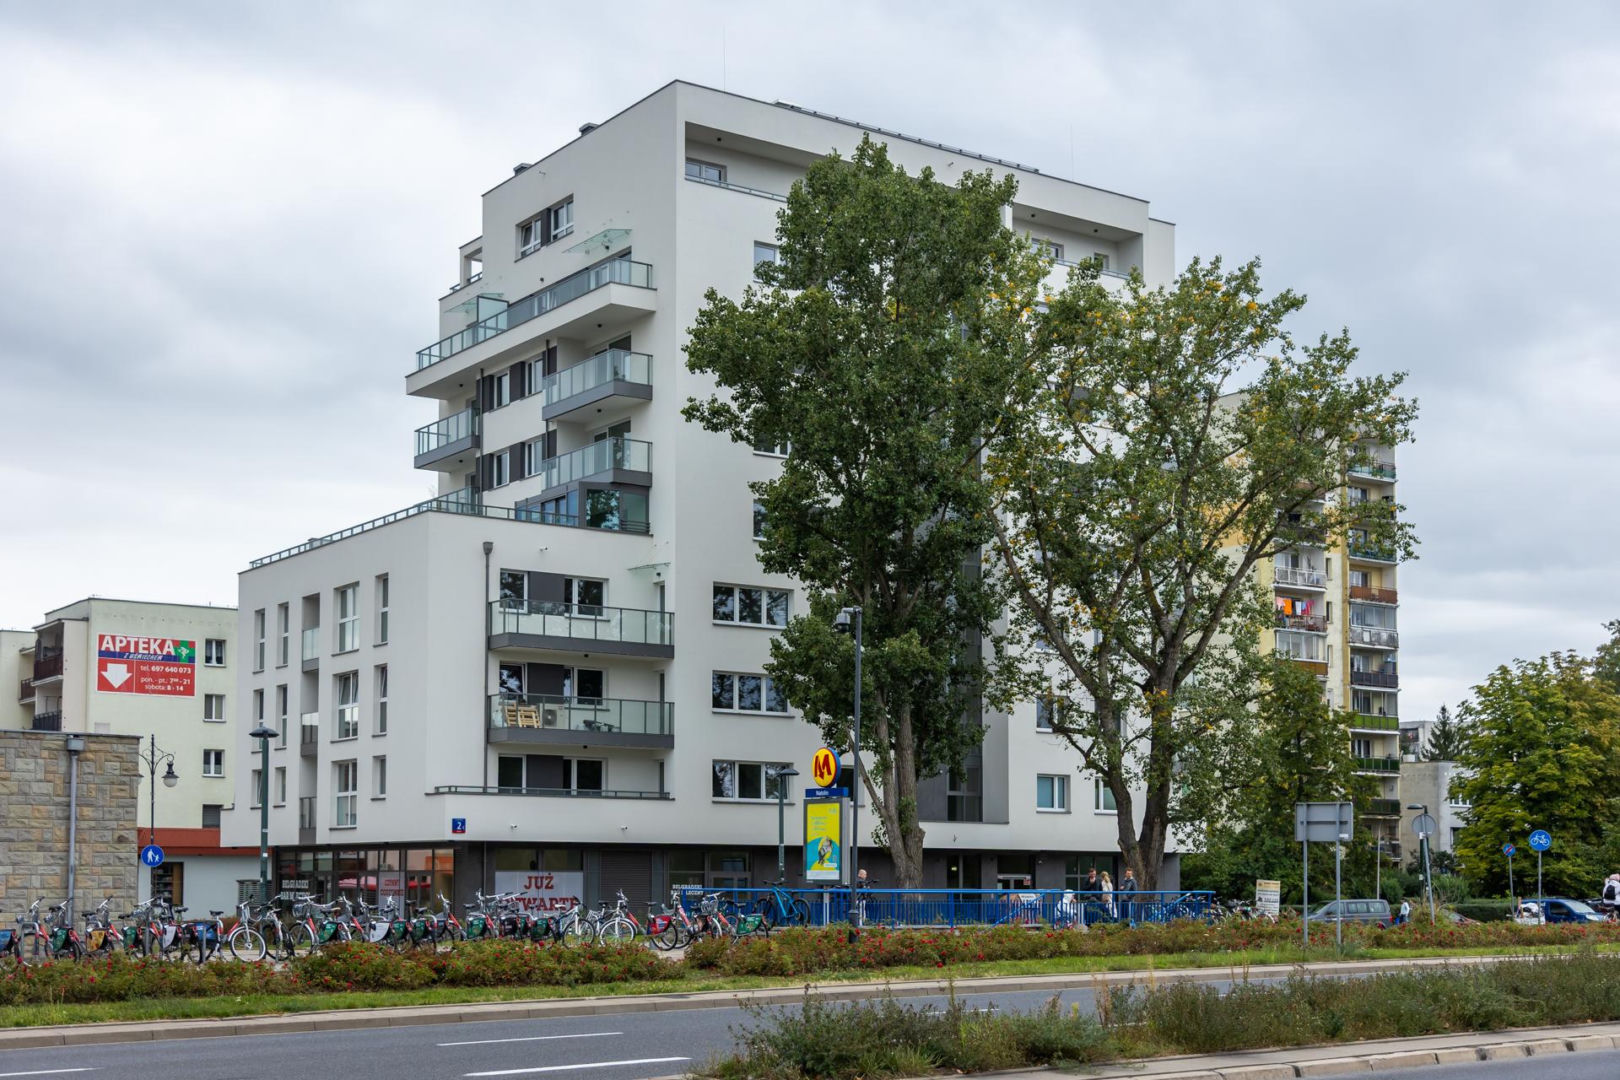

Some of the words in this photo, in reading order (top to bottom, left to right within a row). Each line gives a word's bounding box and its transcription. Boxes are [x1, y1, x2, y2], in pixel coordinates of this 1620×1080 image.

[101, 636, 176, 655] APTEKA
[814, 754, 832, 780] M
[524, 873, 554, 890] JUŻ
[501, 895, 579, 911] WARTE
